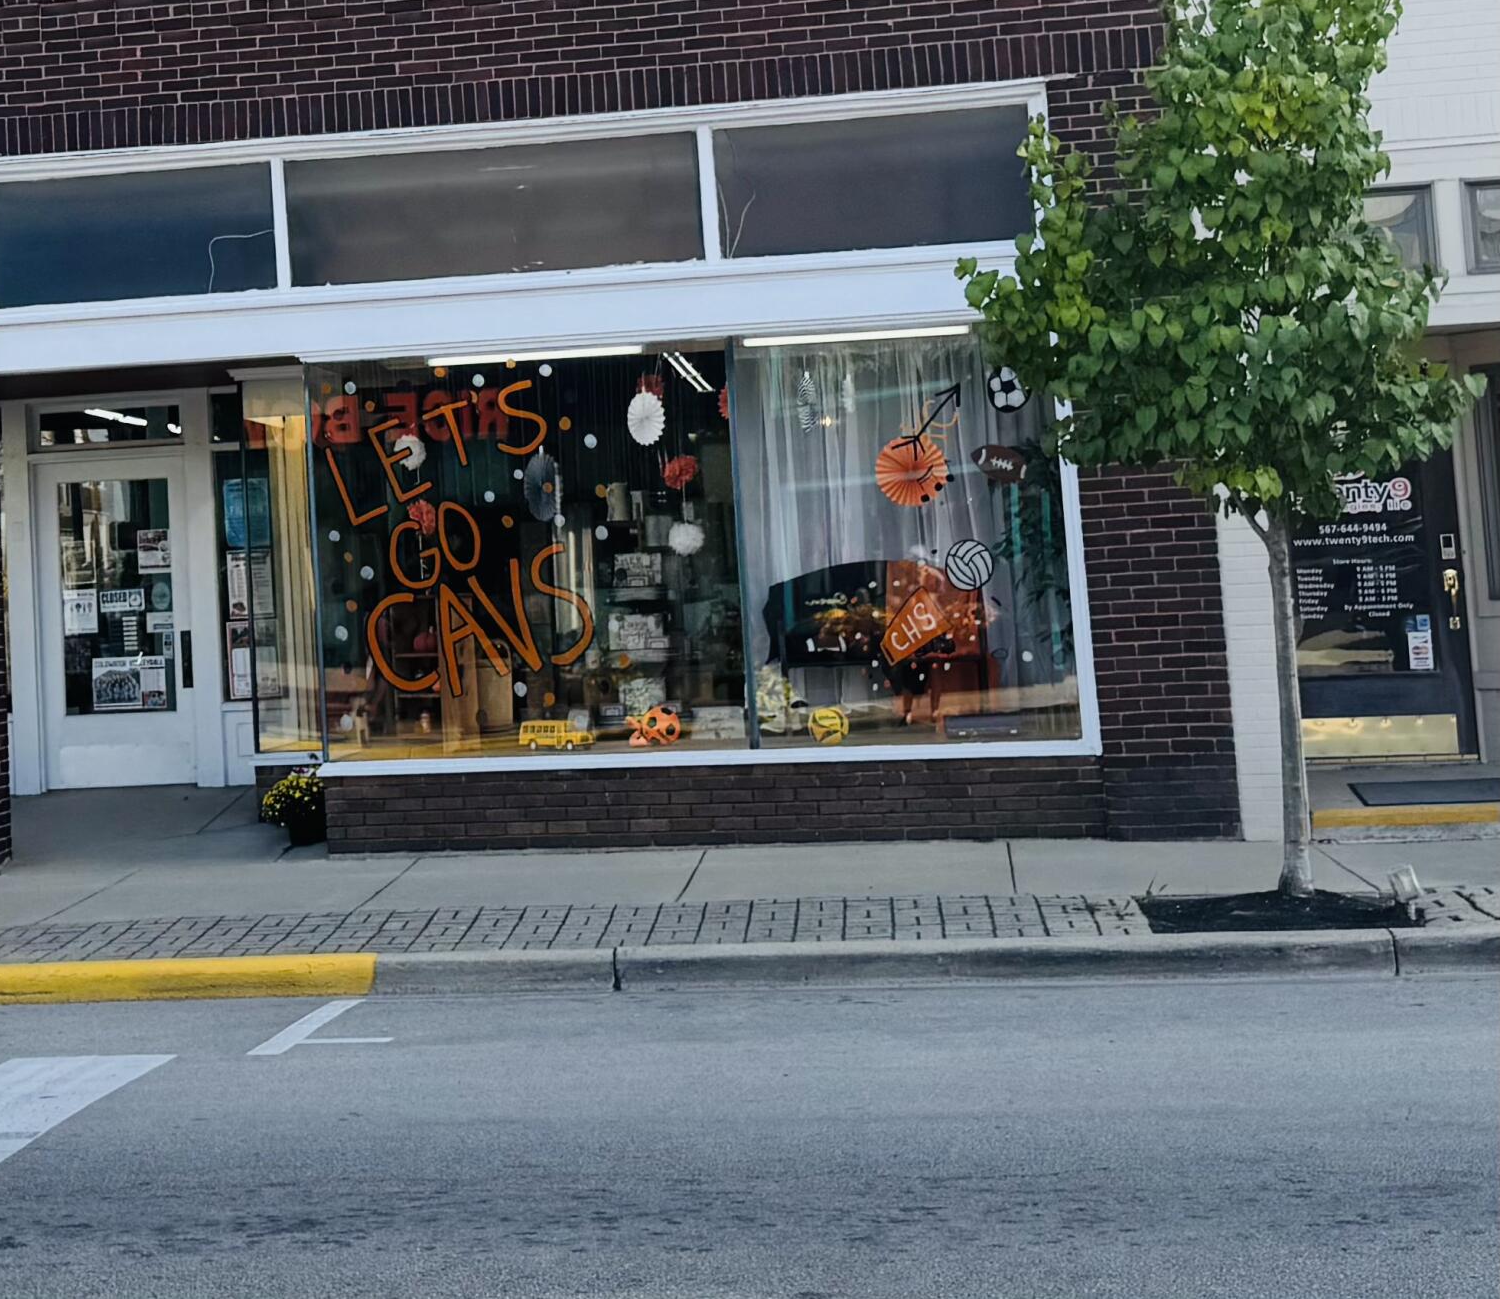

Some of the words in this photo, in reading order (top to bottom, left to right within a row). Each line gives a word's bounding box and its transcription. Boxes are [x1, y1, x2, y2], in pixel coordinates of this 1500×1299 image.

[325, 379, 548, 527] LET'S
[1333, 477, 1412, 504] nty9
[389, 501, 482, 590] GO
[1293, 534, 1415, 548] www.twenty9tech.com
[101, 590, 128, 604] CLOSED
[366, 542, 596, 699] CAVS
[890, 601, 938, 651] CHS
